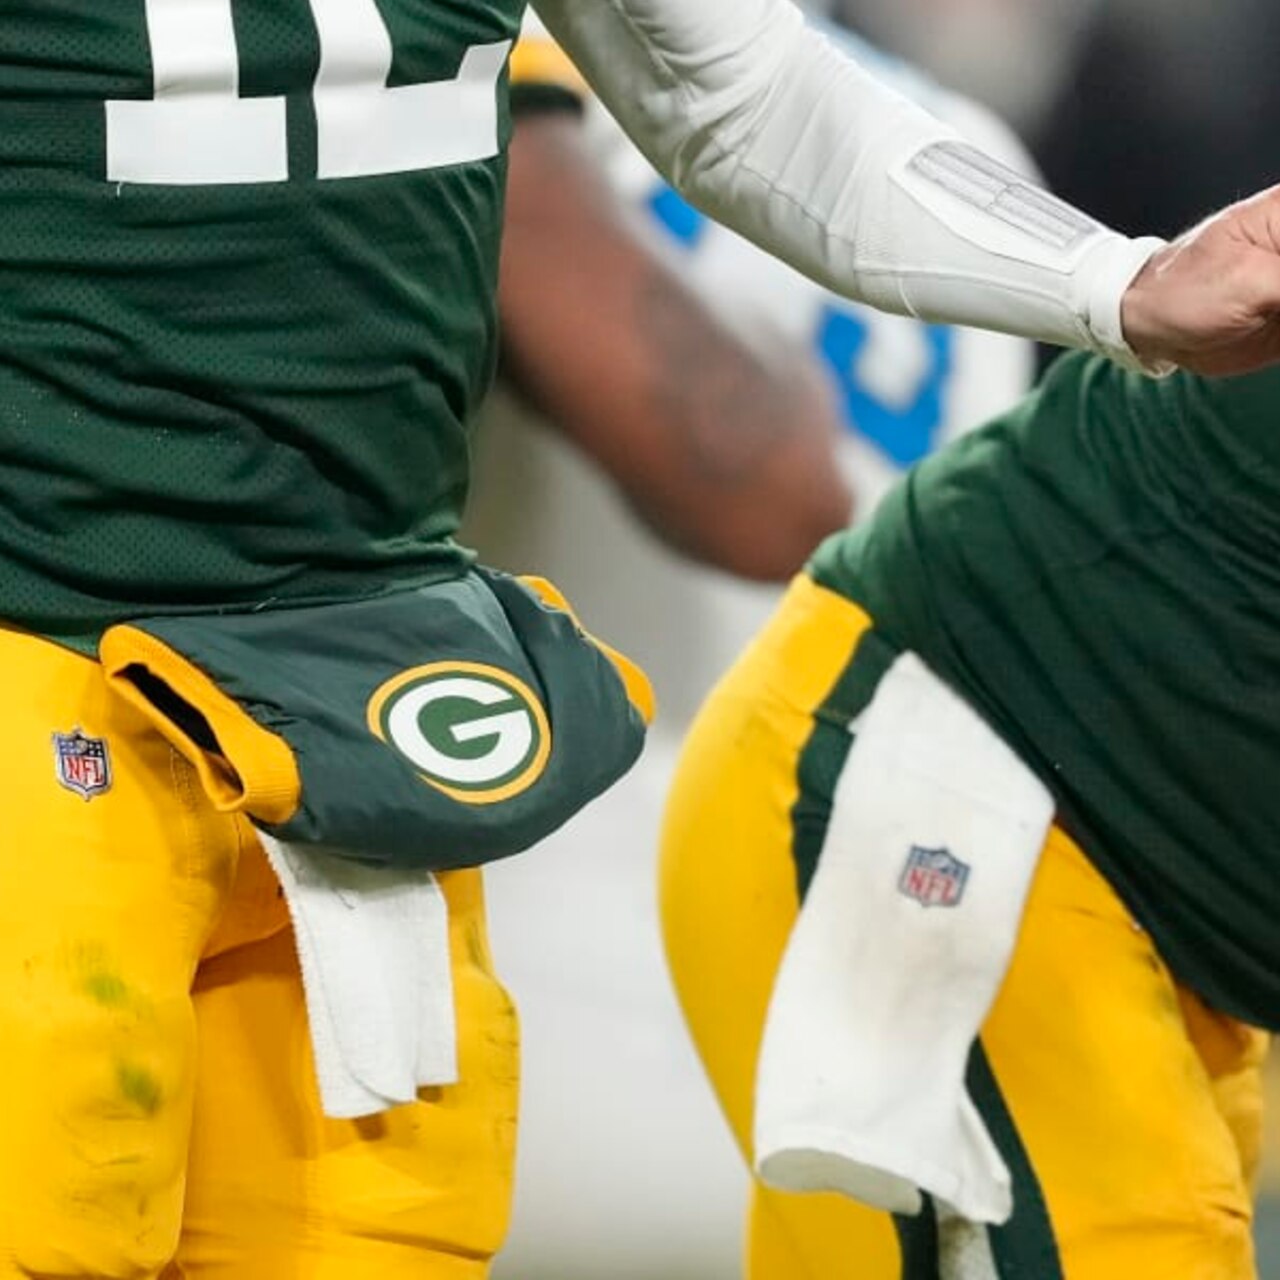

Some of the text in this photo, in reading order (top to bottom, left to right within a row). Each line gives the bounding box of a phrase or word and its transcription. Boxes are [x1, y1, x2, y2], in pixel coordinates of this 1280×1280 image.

[387, 677, 533, 784] G
[65, 755, 105, 785] NFL
[909, 867, 957, 904] NFL
